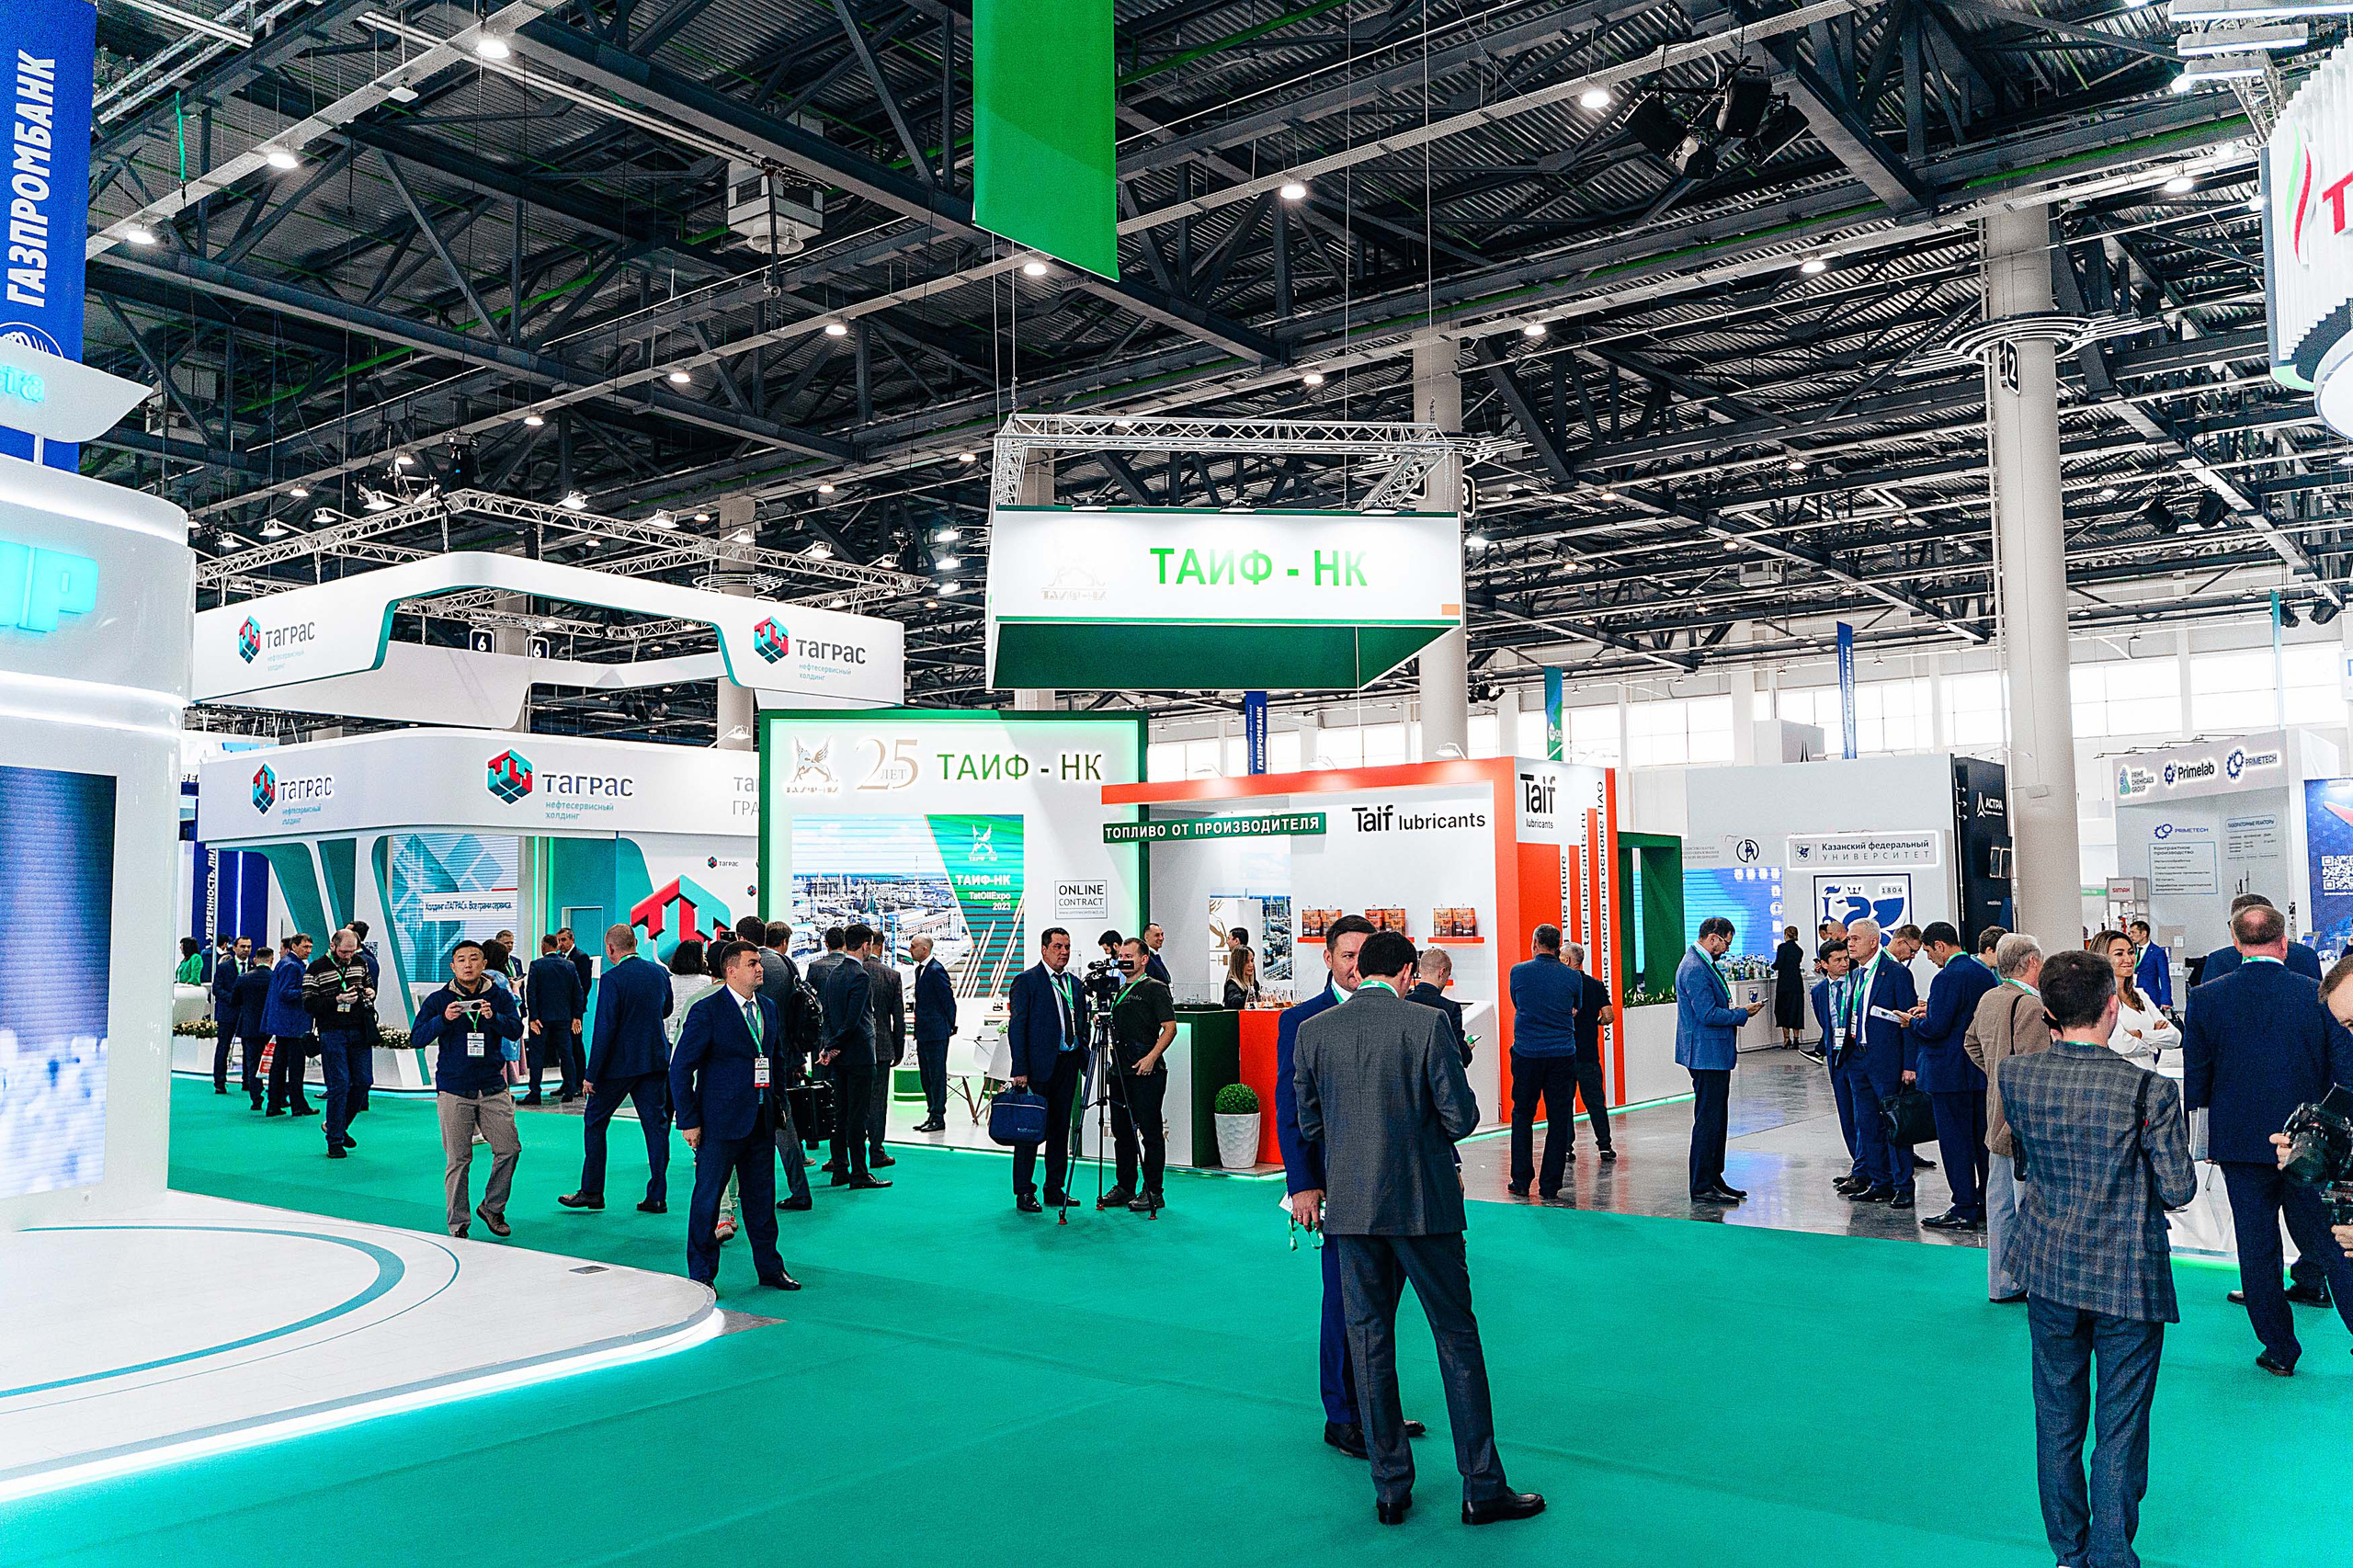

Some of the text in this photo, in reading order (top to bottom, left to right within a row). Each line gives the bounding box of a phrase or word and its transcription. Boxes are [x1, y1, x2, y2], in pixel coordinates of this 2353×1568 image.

[7, 49, 55, 307] ГАЗПРОМБАНК
[2008, 352, 2017, 382] 2
[1150, 548, 1272, 585] ТАИФ
[1314, 550, 1368, 586] НК
[478, 635, 486, 651] 6
[533, 642, 541, 658] 6
[796, 639, 866, 665] таграс
[799, 663, 851, 676] нефтесервисный
[799, 673, 825, 681] холдинг
[855, 738, 918, 790] 25
[937, 754, 1029, 781] ТАИФ
[1062, 754, 1102, 781] НК
[2245, 754, 2277, 767] PRIMETECH
[881, 768, 907, 780] ЛЕТ
[2177, 761, 2215, 779] Primelab
[542, 774, 633, 797] таграс
[2131, 785, 2146, 793] GROUP
[1520, 773, 1556, 814] Taif
[545, 801, 614, 812] нефтесервисный
[1985, 797, 2004, 812] АСТРА
[545, 812, 580, 820] холдинг
[1352, 804, 1485, 832] Taif lubricants
[1526, 818, 1553, 829] lubricants
[1105, 816, 1319, 839] ТОПЛИВО ОТ ПРОИЗВОДИТЕЛЯ
[1822, 839, 1929, 851] Казанский федеральный
[1823, 851, 1929, 861] УНИВЕРСИТЕТ
[955, 875, 1011, 886] ТАИФ-НК
[1581, 812, 1590, 946] taif-lubricants.ru
[969, 892, 1011, 902] TatOilExpo
[1059, 885, 1104, 895] ONLINE
[1601, 881, 1607, 899] на
[993, 902, 1011, 911] 2023
[1059, 897, 1103, 906] CONTRACT
